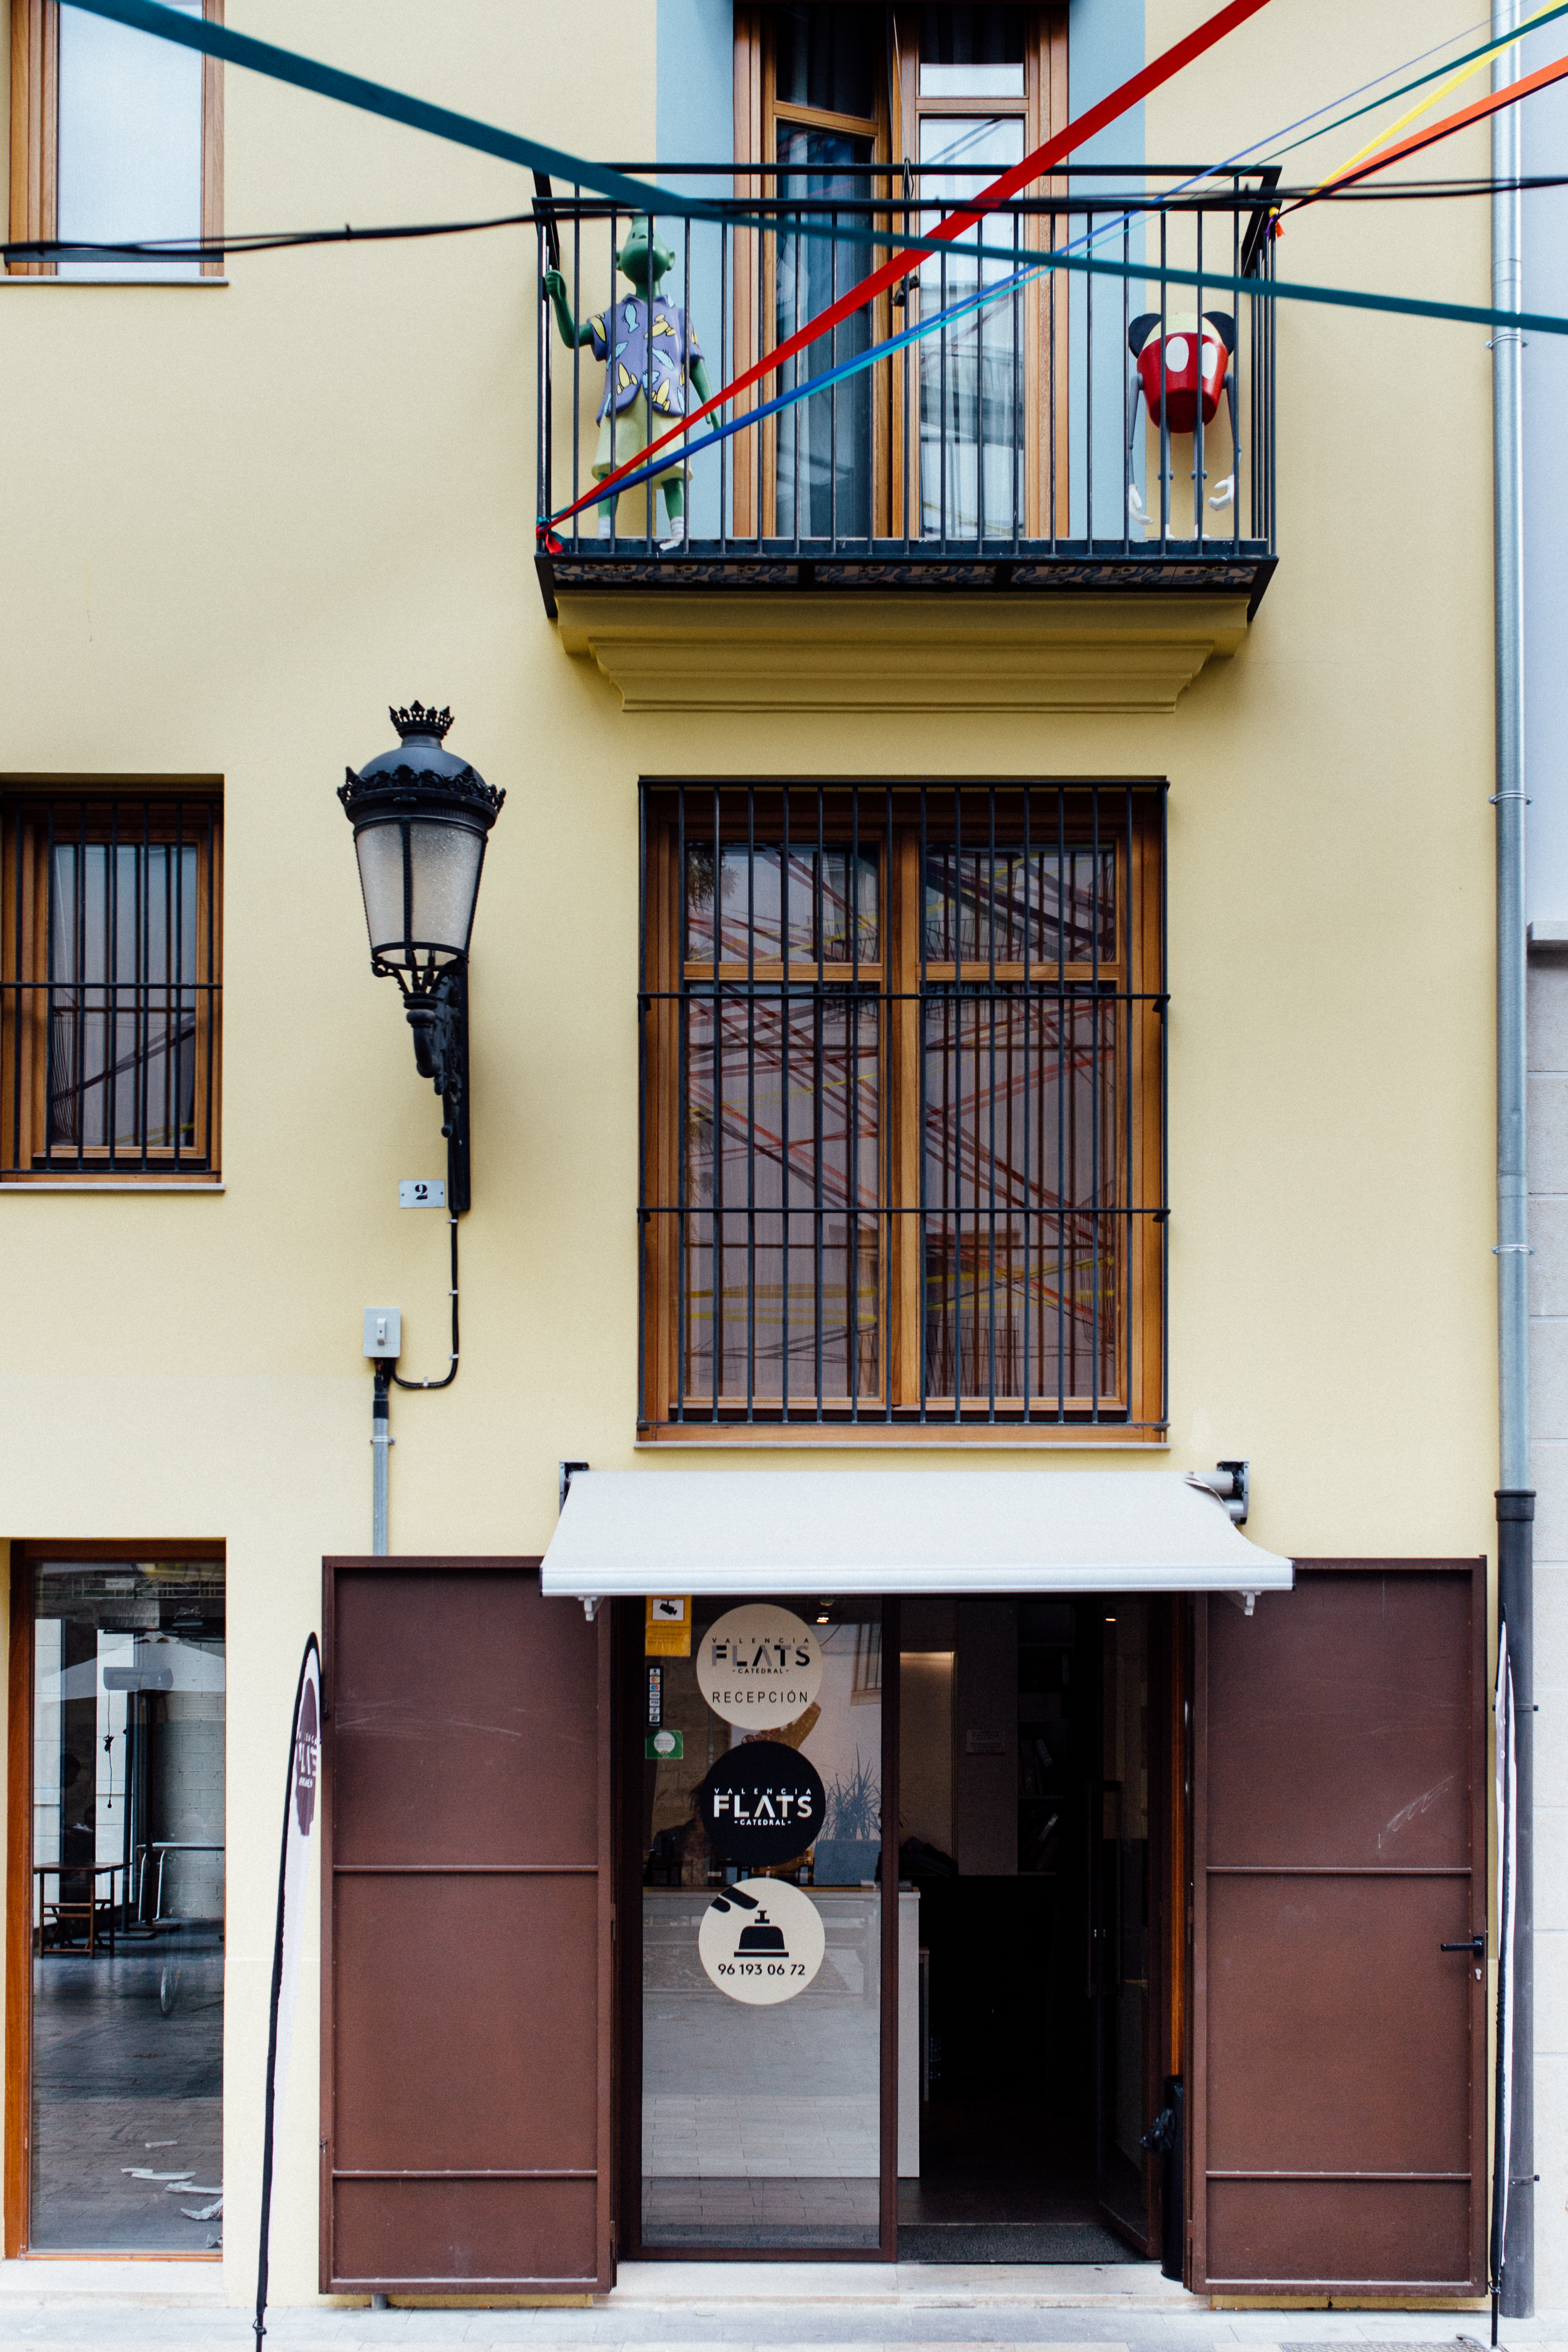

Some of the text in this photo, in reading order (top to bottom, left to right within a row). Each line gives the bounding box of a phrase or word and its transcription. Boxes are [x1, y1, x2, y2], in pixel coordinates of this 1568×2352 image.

[414, 1184, 428, 1200] 2
[712, 1645, 810, 1667] FLATS
[712, 1690, 807, 1703] RECEPCIÓN
[714, 1795, 812, 1818] FLATS
[718, 1963, 805, 1975] 96 193 06 72
